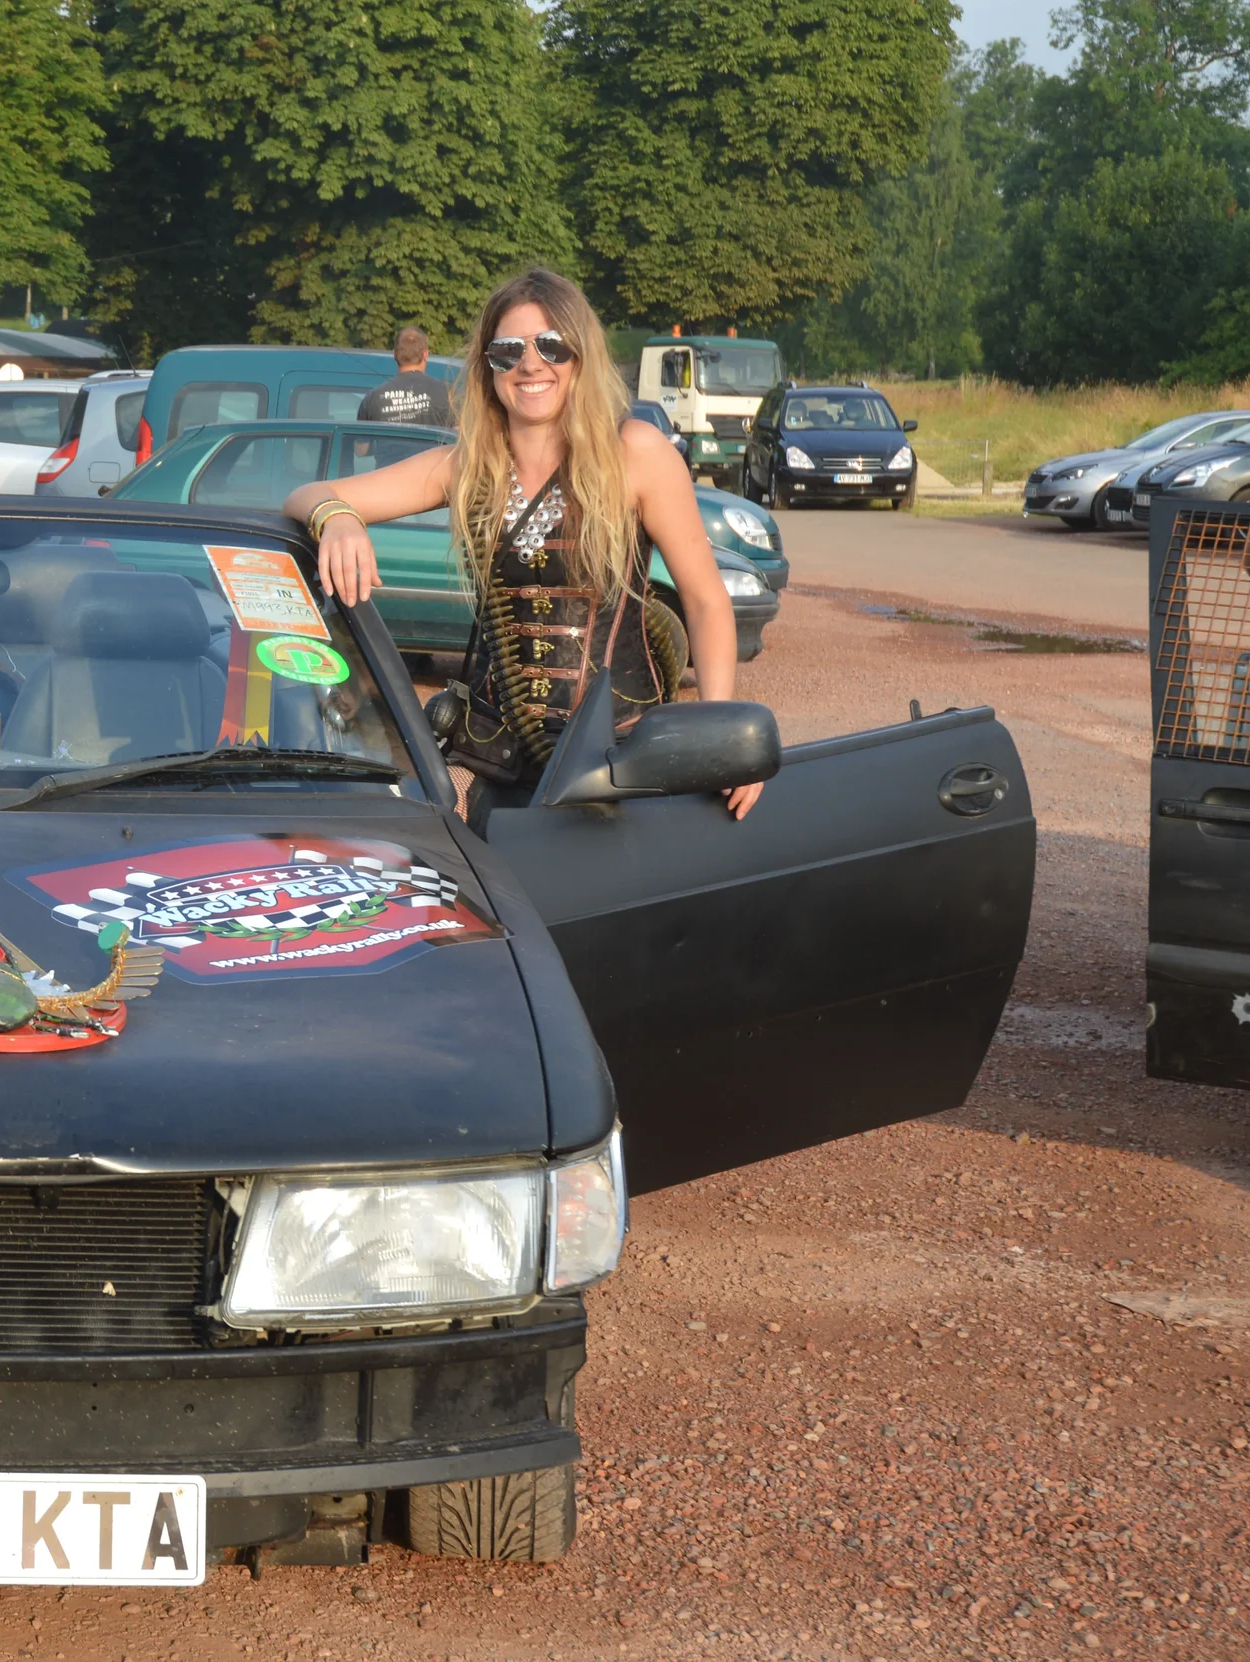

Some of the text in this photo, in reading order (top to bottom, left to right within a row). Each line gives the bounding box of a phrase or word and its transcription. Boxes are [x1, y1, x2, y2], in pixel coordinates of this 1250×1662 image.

[384, 390, 405, 399] PAIN
[276, 589, 294, 599] IN
[262, 636, 329, 652] RESERVED
[285, 648, 323, 675] P
[281, 669, 340, 683] PARKING
[139, 876, 399, 927] Wacky Rally
[209, 919, 466, 968] www.wackyrally.co.uk
[21, 1490, 189, 1571] KTA
